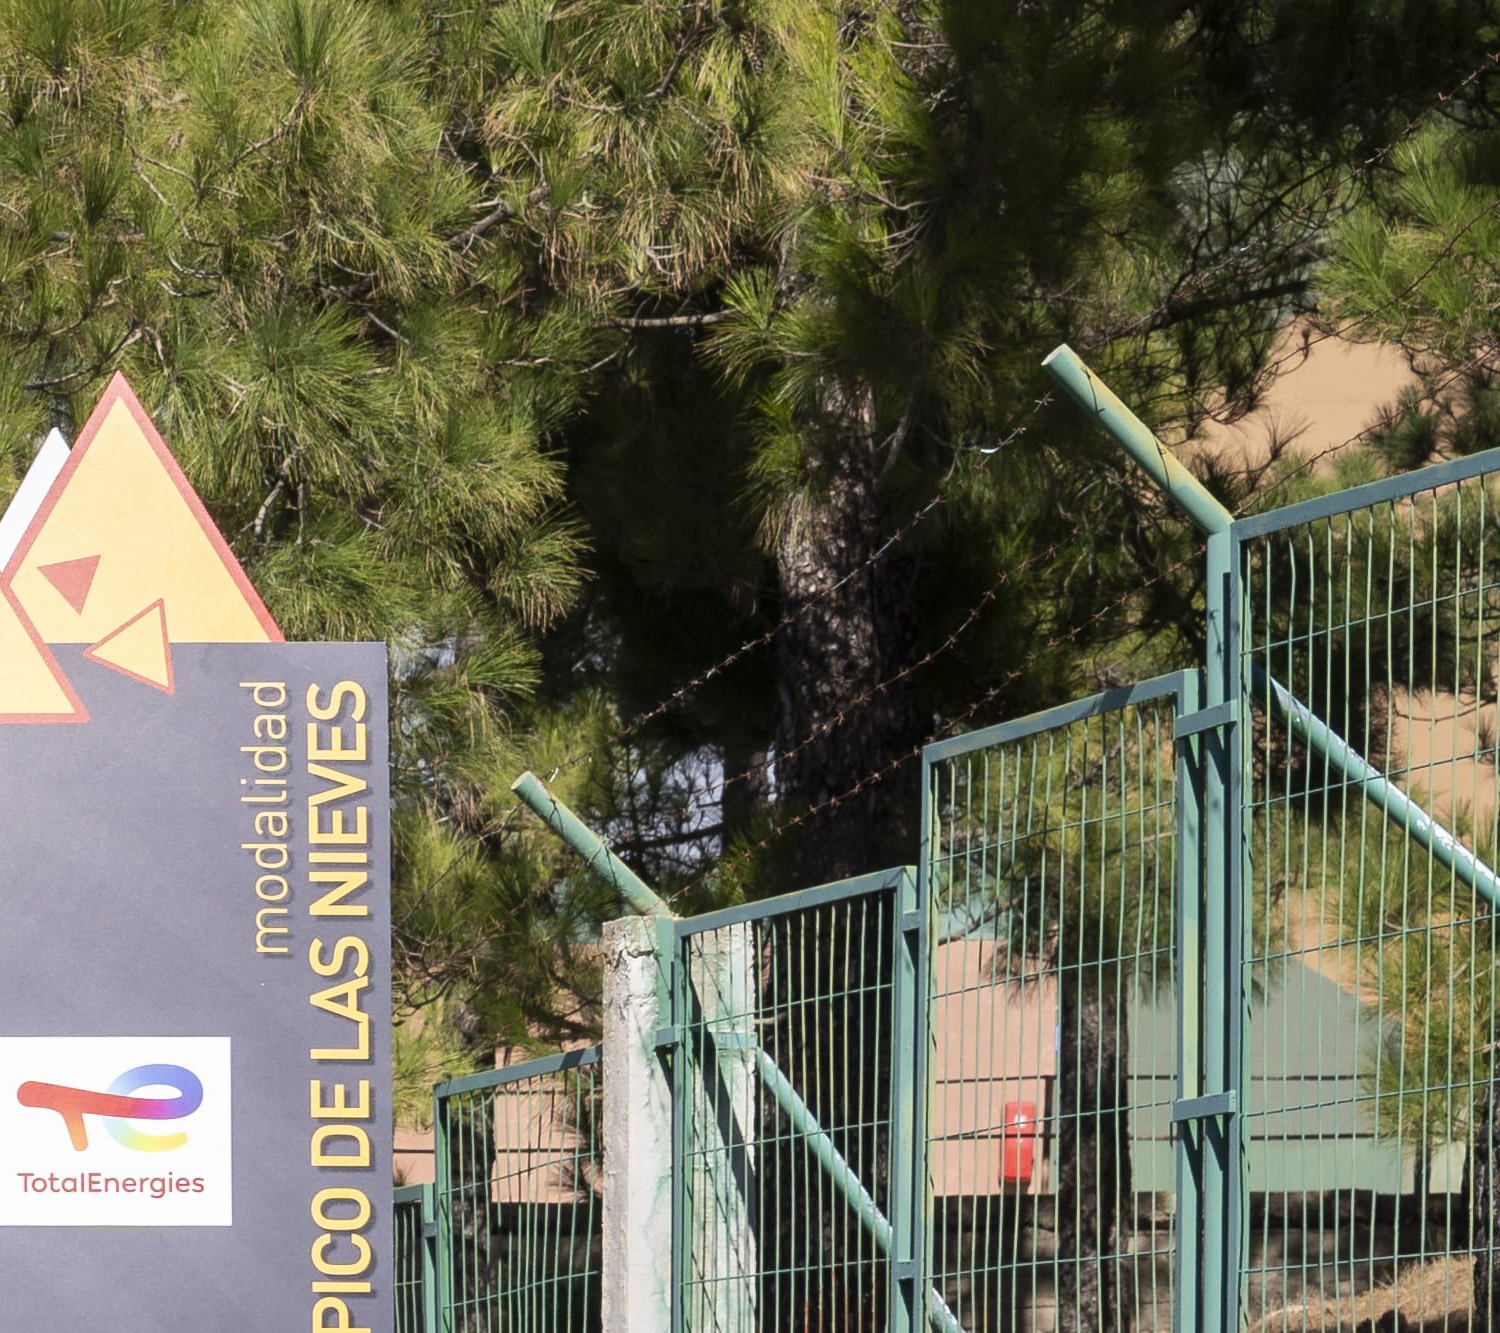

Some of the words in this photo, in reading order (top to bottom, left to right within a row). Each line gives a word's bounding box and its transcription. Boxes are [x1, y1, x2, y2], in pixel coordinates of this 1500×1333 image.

[240, 680, 288, 954] modalidad
[306, 679, 369, 917] NIEVES
[309, 935, 371, 1060] LAS
[17, 1171, 205, 1199] TotalEnergies
[310, 1079, 371, 1168] DE
